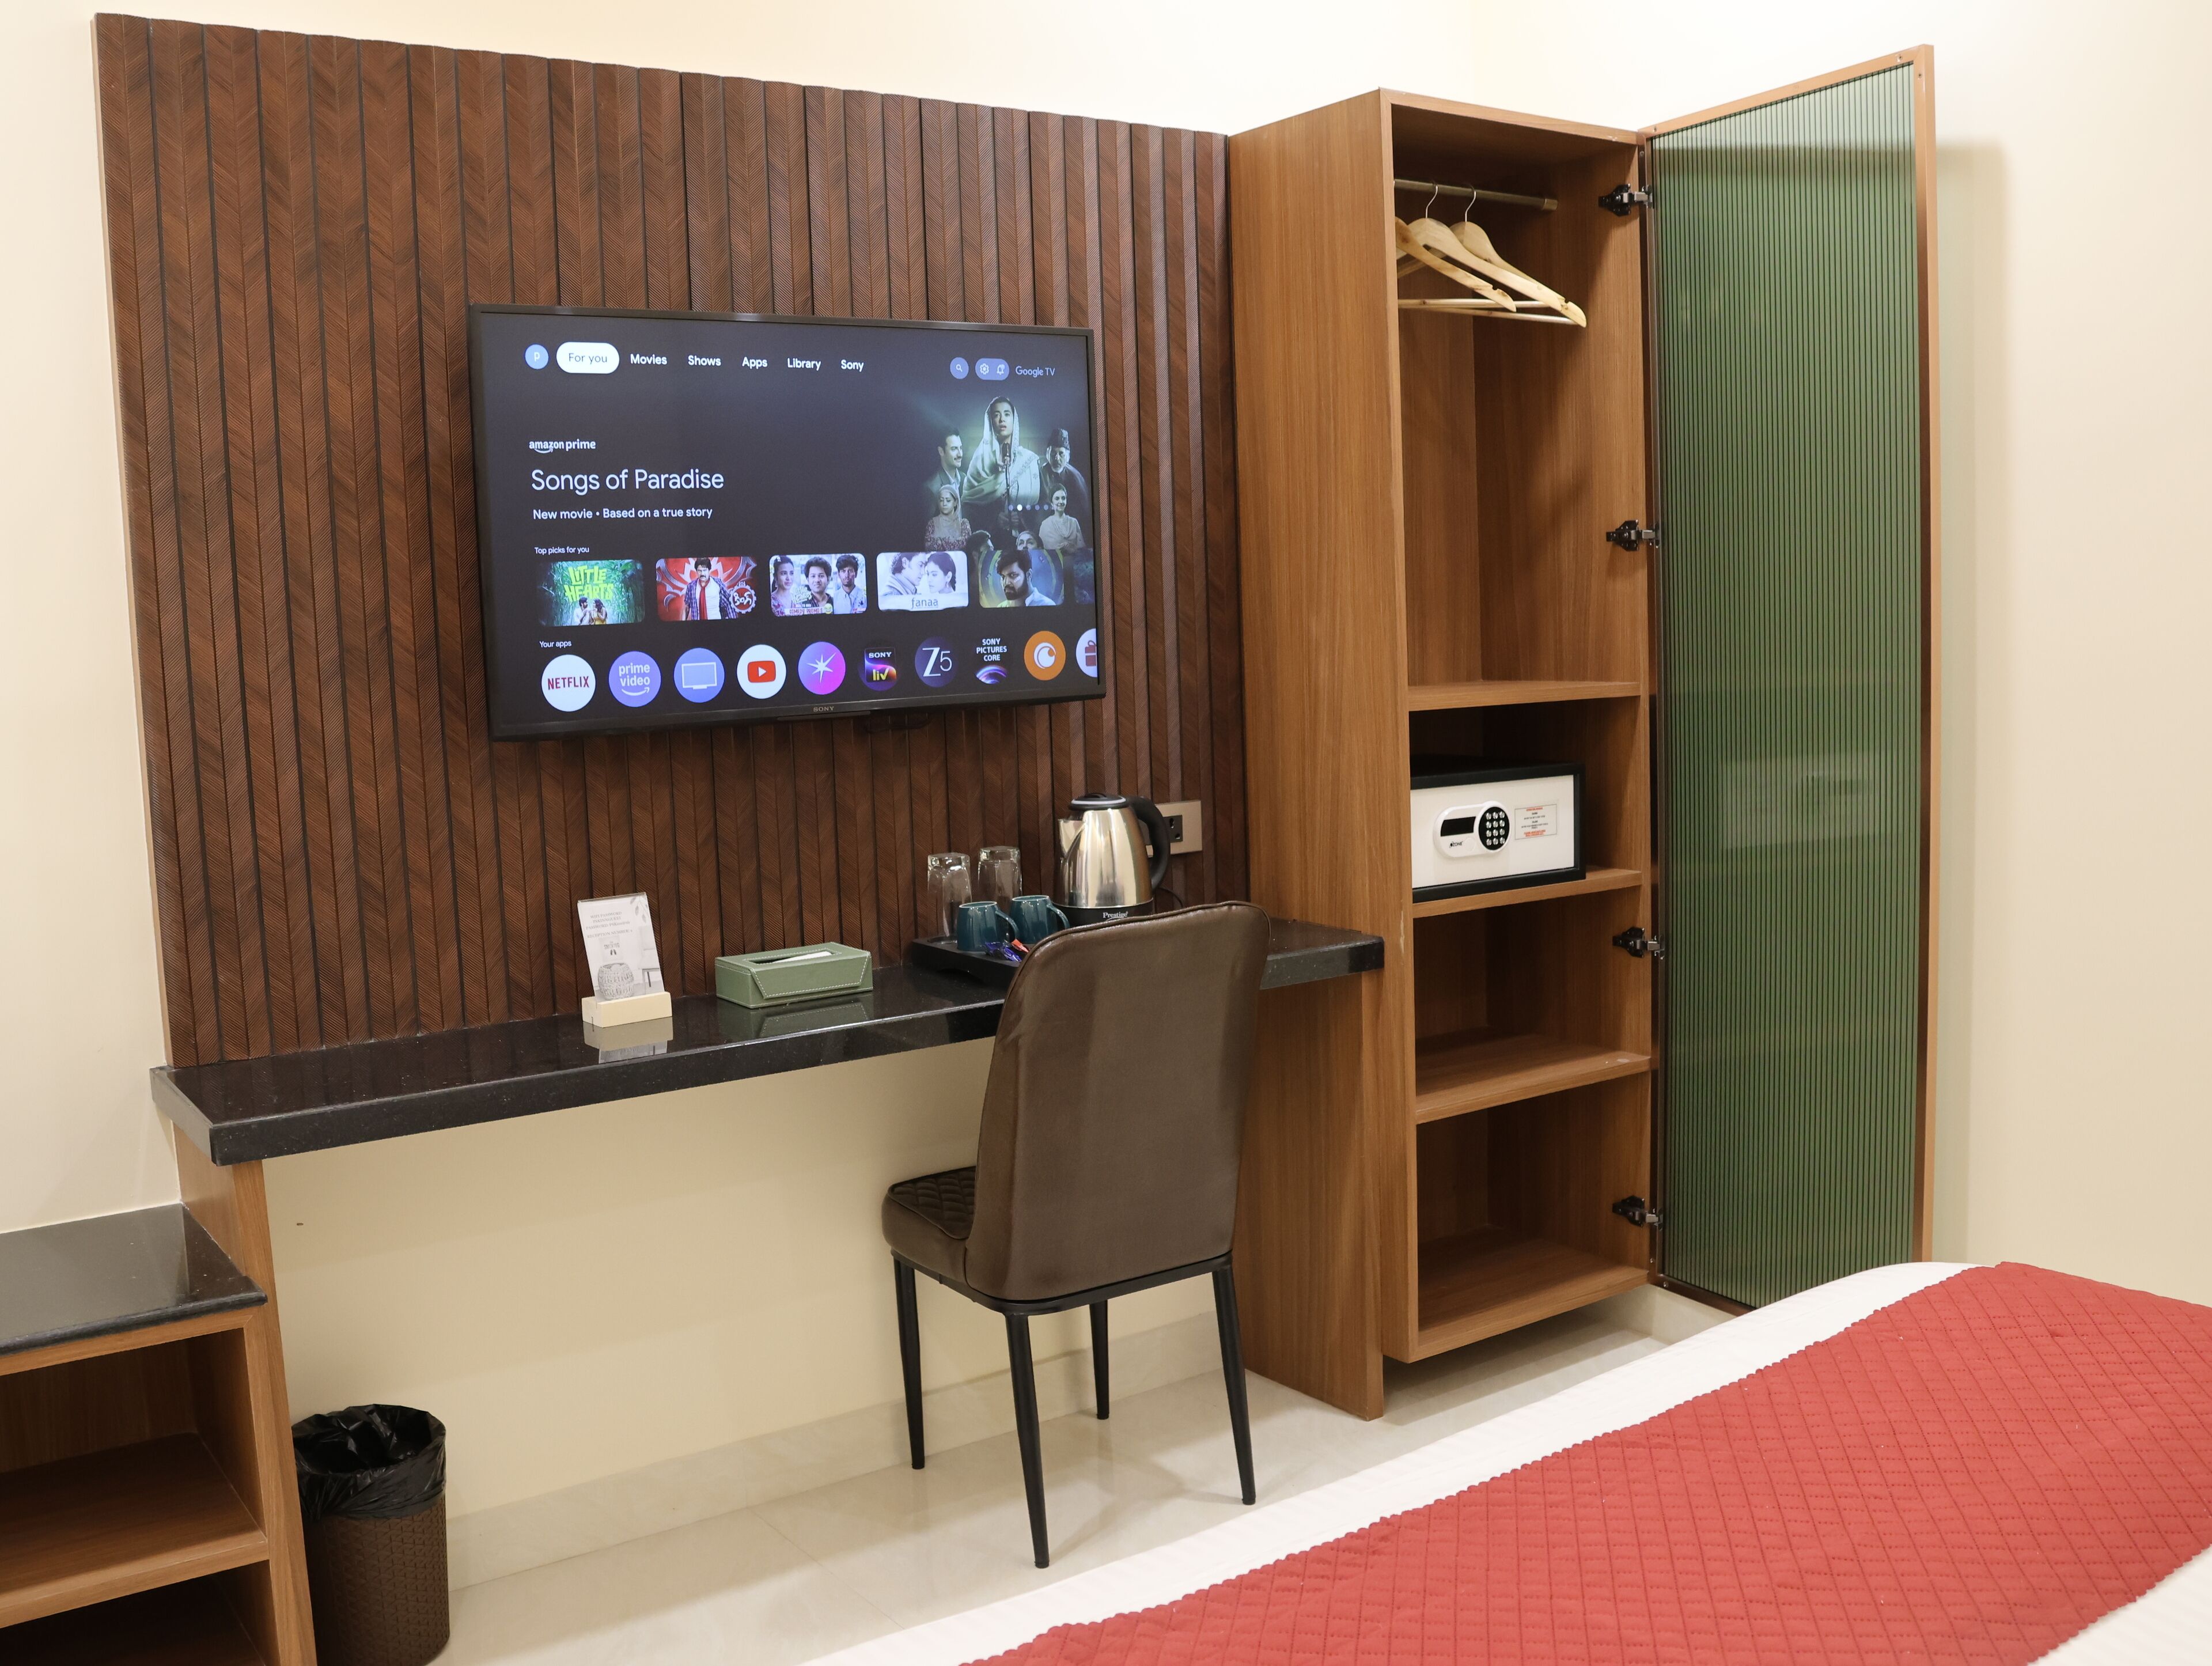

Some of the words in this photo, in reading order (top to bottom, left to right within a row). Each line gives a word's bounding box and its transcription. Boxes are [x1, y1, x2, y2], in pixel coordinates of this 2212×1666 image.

[569, 353, 585, 362] For
[589, 356, 607, 364] you
[631, 354, 667, 365] Movies
[688, 355, 721, 366] Shows
[742, 357, 767, 369] Apps
[787, 358, 821, 370] Library
[841, 359, 863, 372] Sony
[1016, 366, 1043, 377] Google
[1045, 368, 1055, 376] TV
[529, 441, 564, 450] amazon
[566, 439, 596, 451] prime
[532, 469, 600, 495] Songs
[606, 469, 628, 489] of
[635, 469, 724, 489] Paradise
[533, 509, 557, 519] New
[560, 509, 592, 518] movie
[603, 508, 635, 518] Based
[662, 508, 683, 517] true
[686, 508, 712, 518] story
[564, 583, 613, 603] HEARTS
[912, 597, 938, 609] fanaa
[976, 646, 1007, 654] PICTURES
[922, 648, 952, 676] Z5
[619, 662, 650, 675] prime
[548, 676, 589, 690] NETFLIX
[619, 674, 650, 686] video
